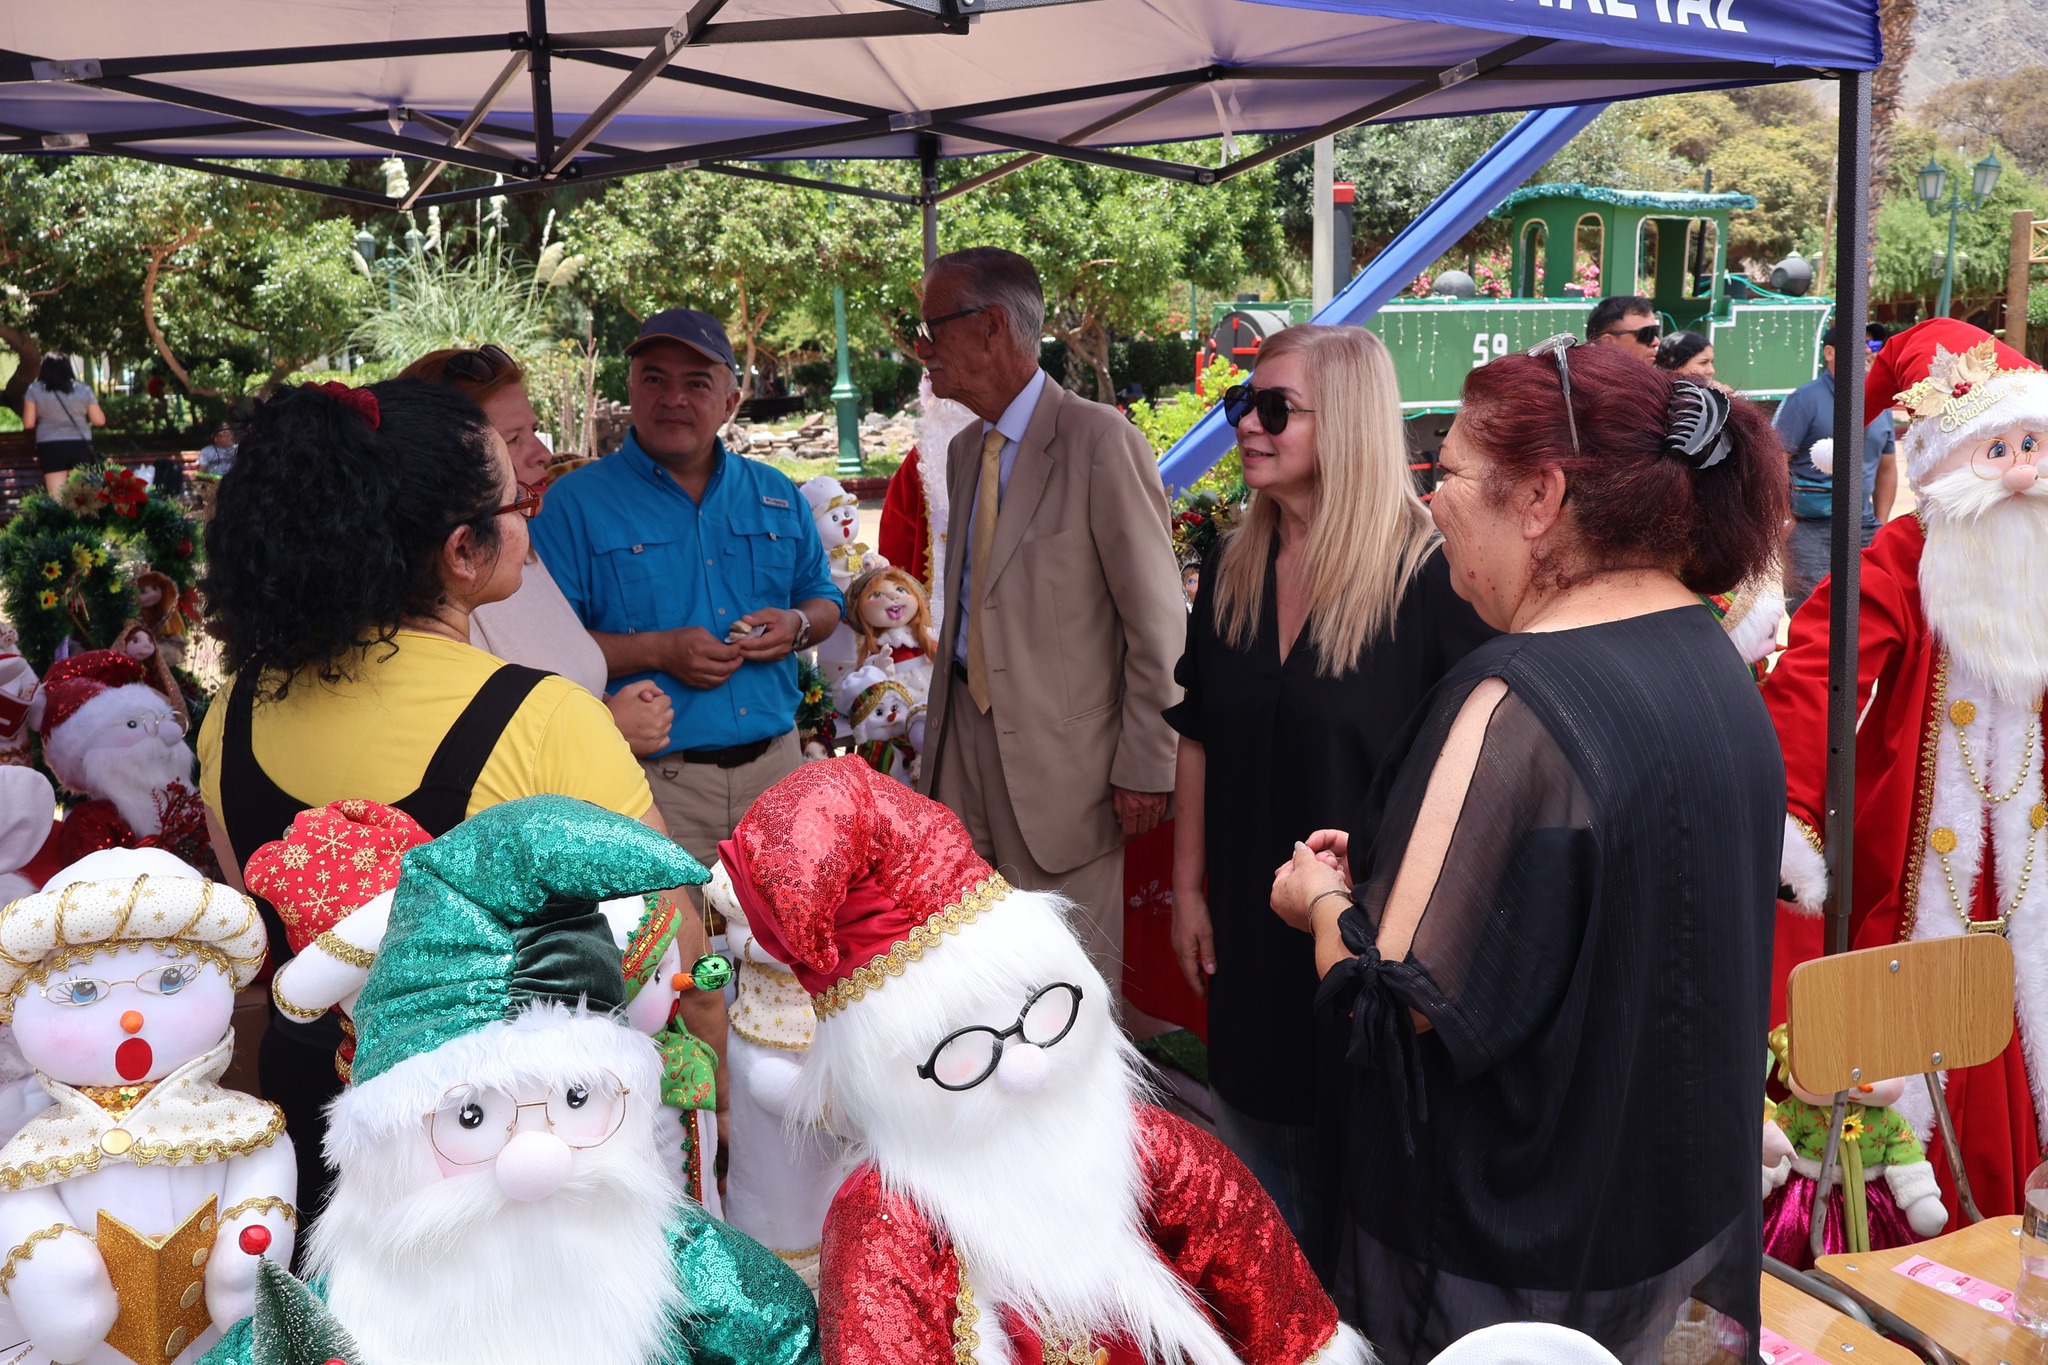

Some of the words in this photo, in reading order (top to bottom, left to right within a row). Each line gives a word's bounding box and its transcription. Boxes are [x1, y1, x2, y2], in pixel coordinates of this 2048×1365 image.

[1472, 332, 1509, 368] 59
[1939, 388, 2008, 433] Christmas
[1940, 381, 1990, 415] Merry
